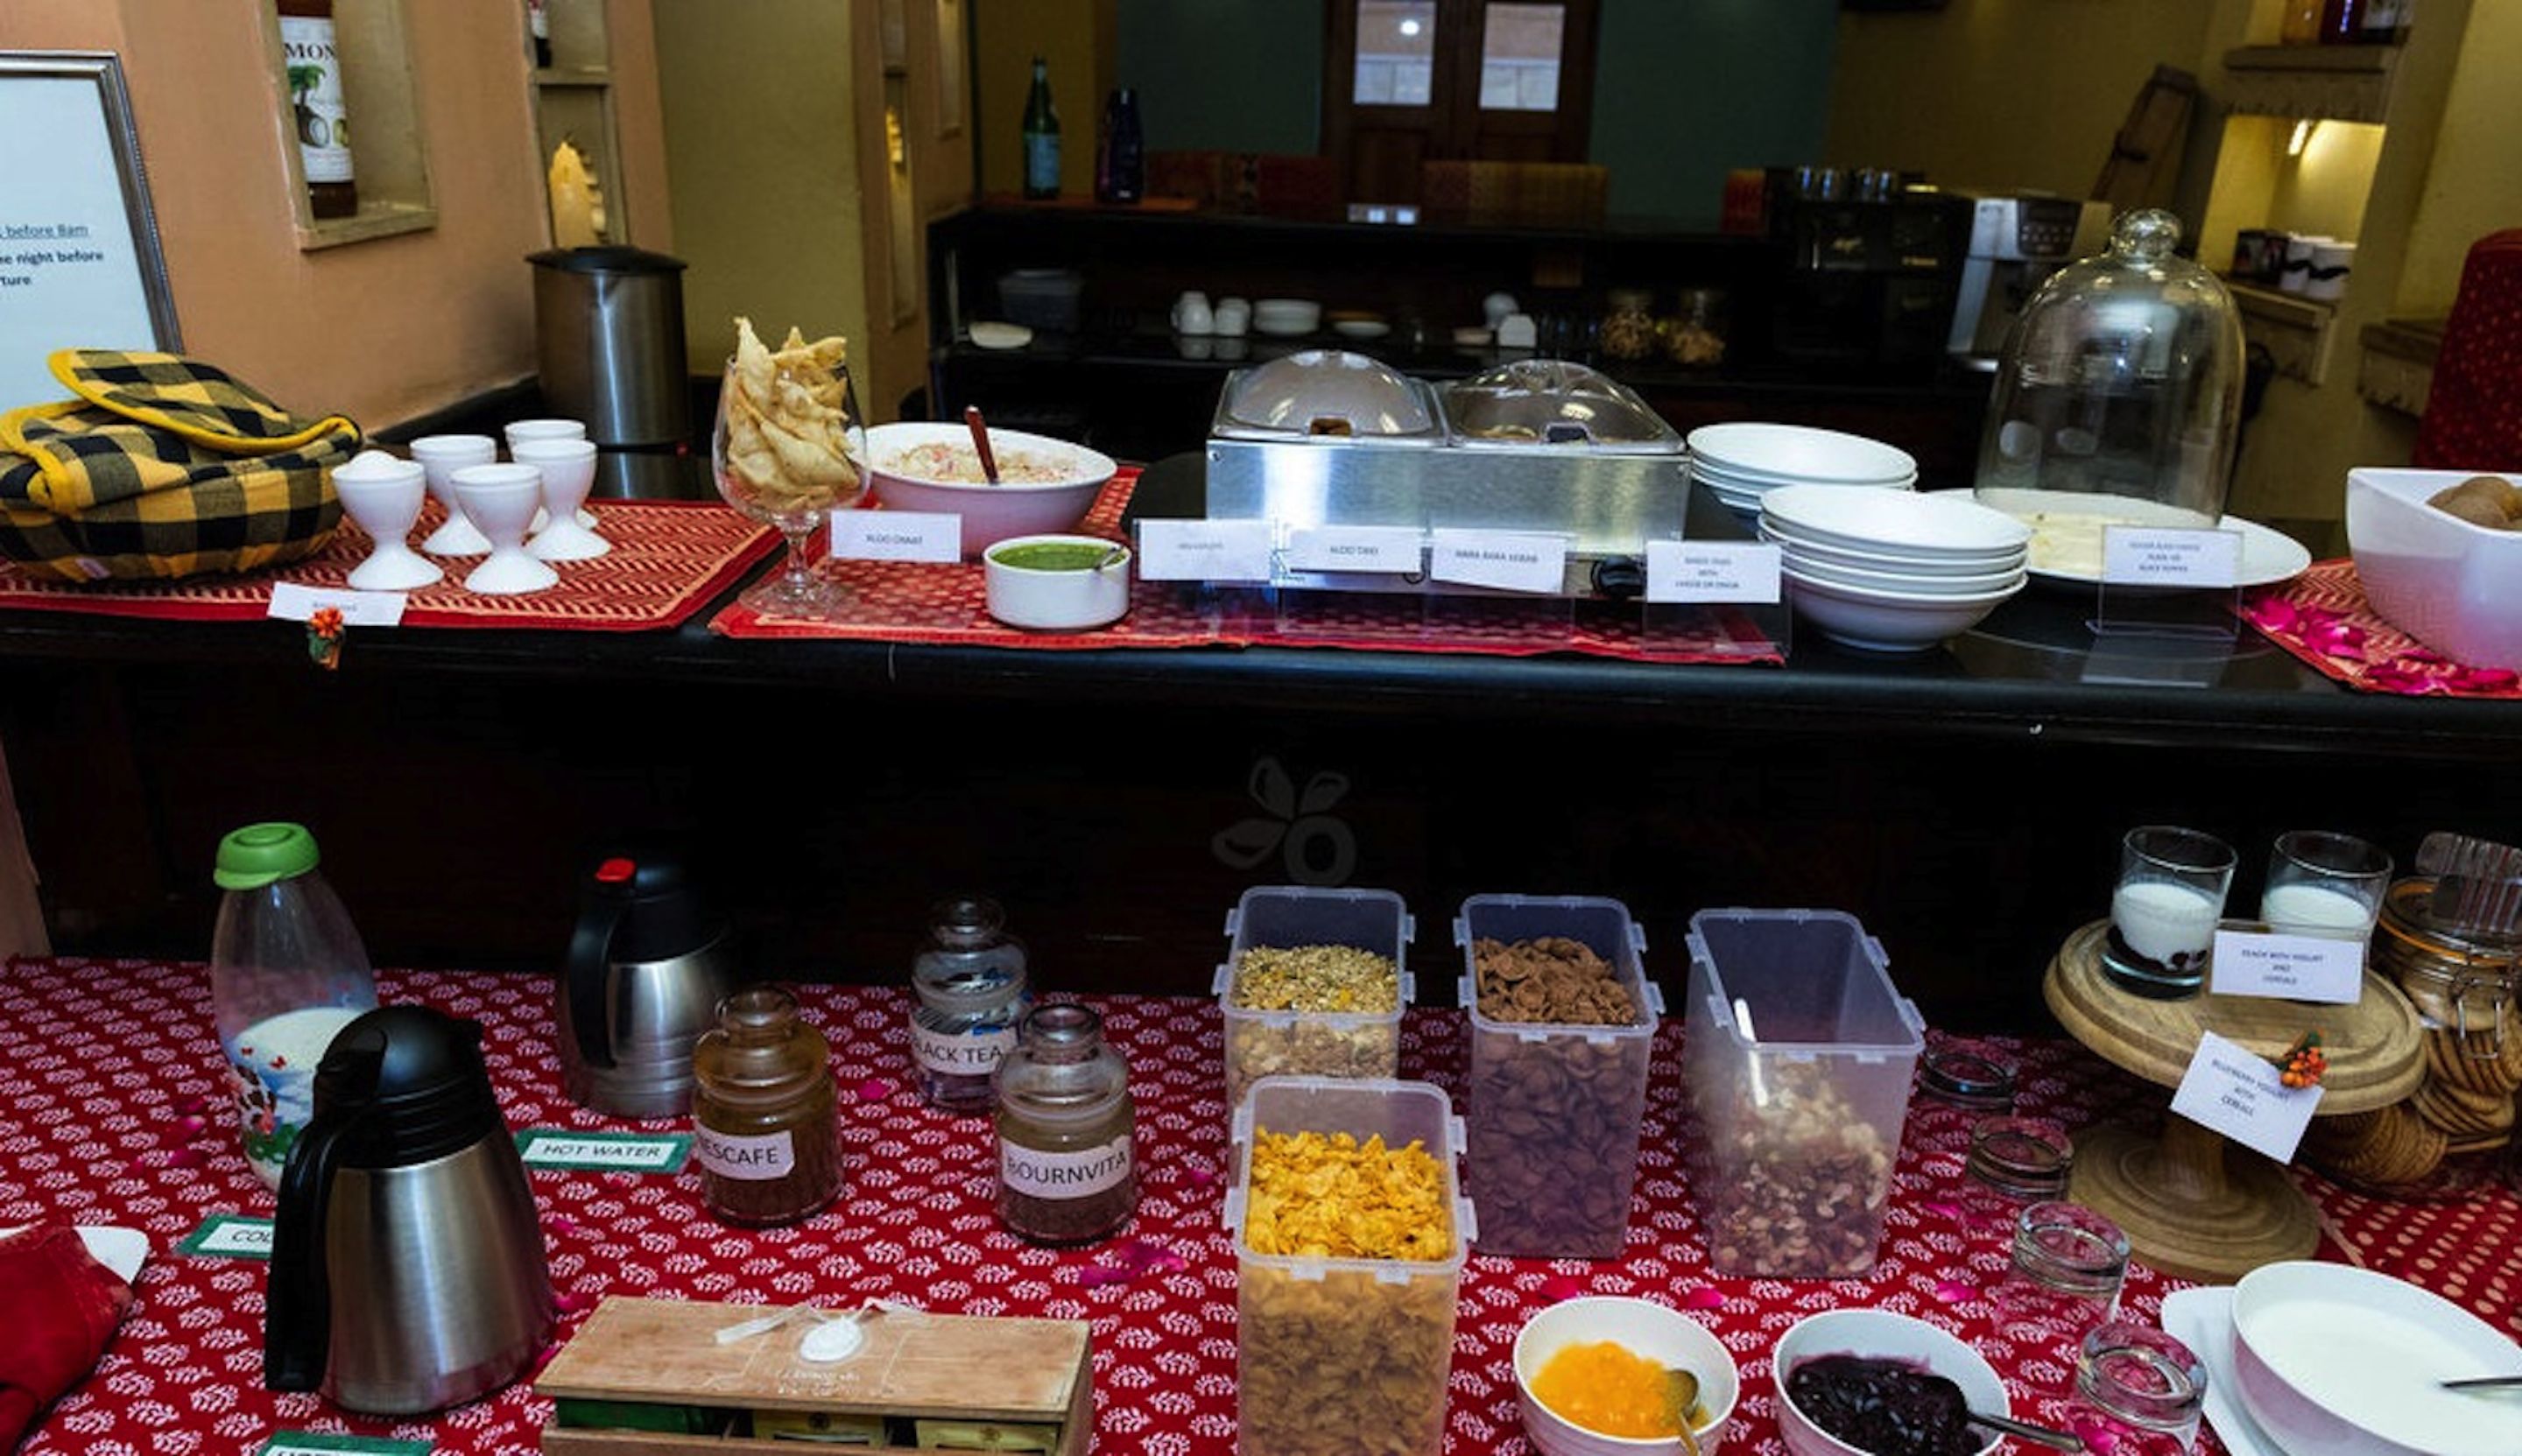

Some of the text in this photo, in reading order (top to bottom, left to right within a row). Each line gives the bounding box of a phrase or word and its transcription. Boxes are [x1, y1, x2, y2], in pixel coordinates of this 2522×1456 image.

[6, 223, 88, 238] before 8am
[17, 251, 53, 266] night
[56, 248, 104, 263] before
[963, 1045, 1003, 1063] TEA
[543, 1143, 660, 1157] HOT WATER
